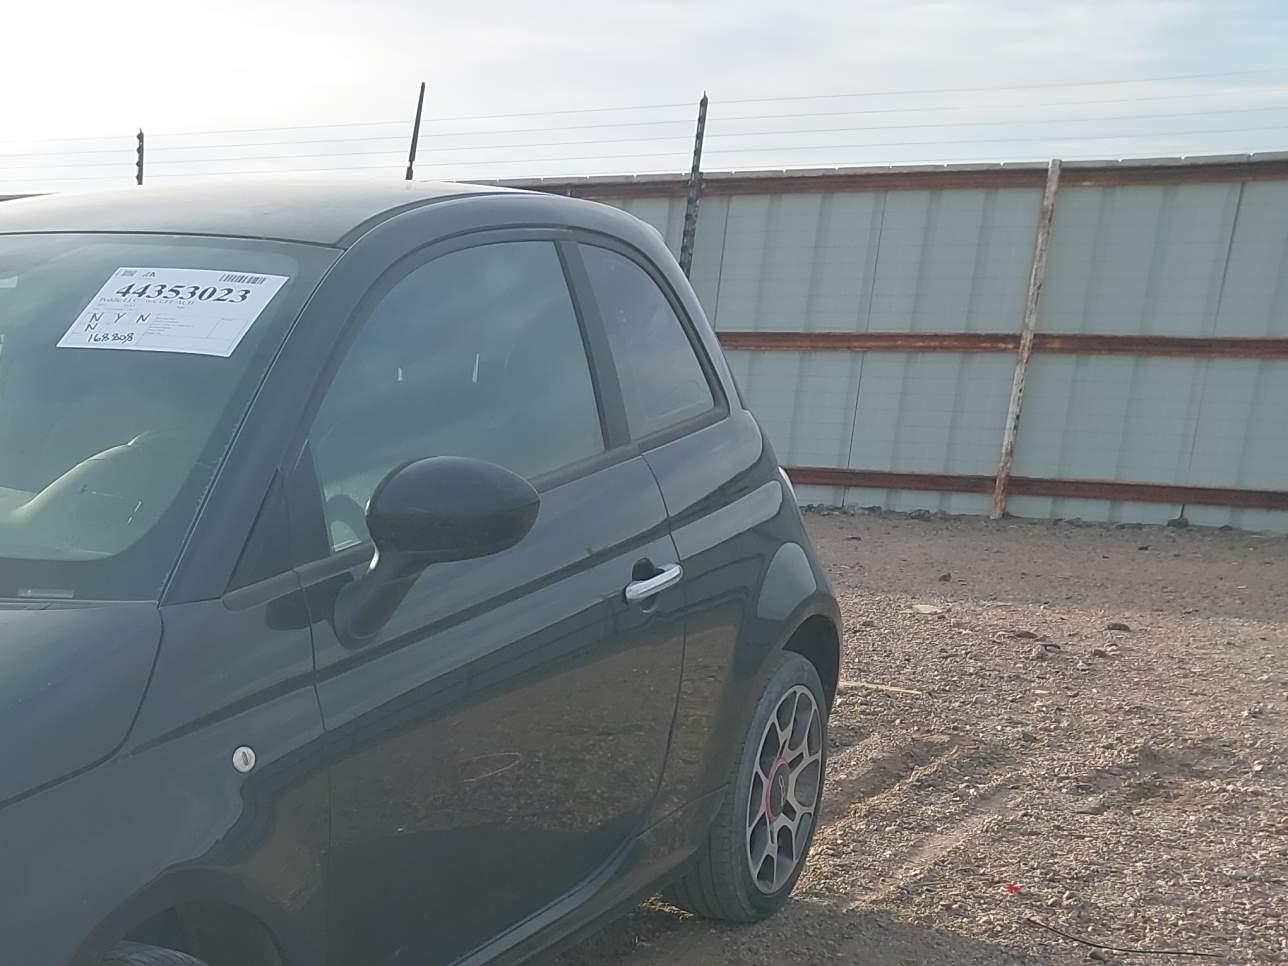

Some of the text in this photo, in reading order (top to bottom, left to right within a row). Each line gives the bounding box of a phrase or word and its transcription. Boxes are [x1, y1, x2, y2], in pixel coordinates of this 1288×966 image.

[116, 283, 251, 303] 44353023
[89, 312, 152, 324] N Y N
